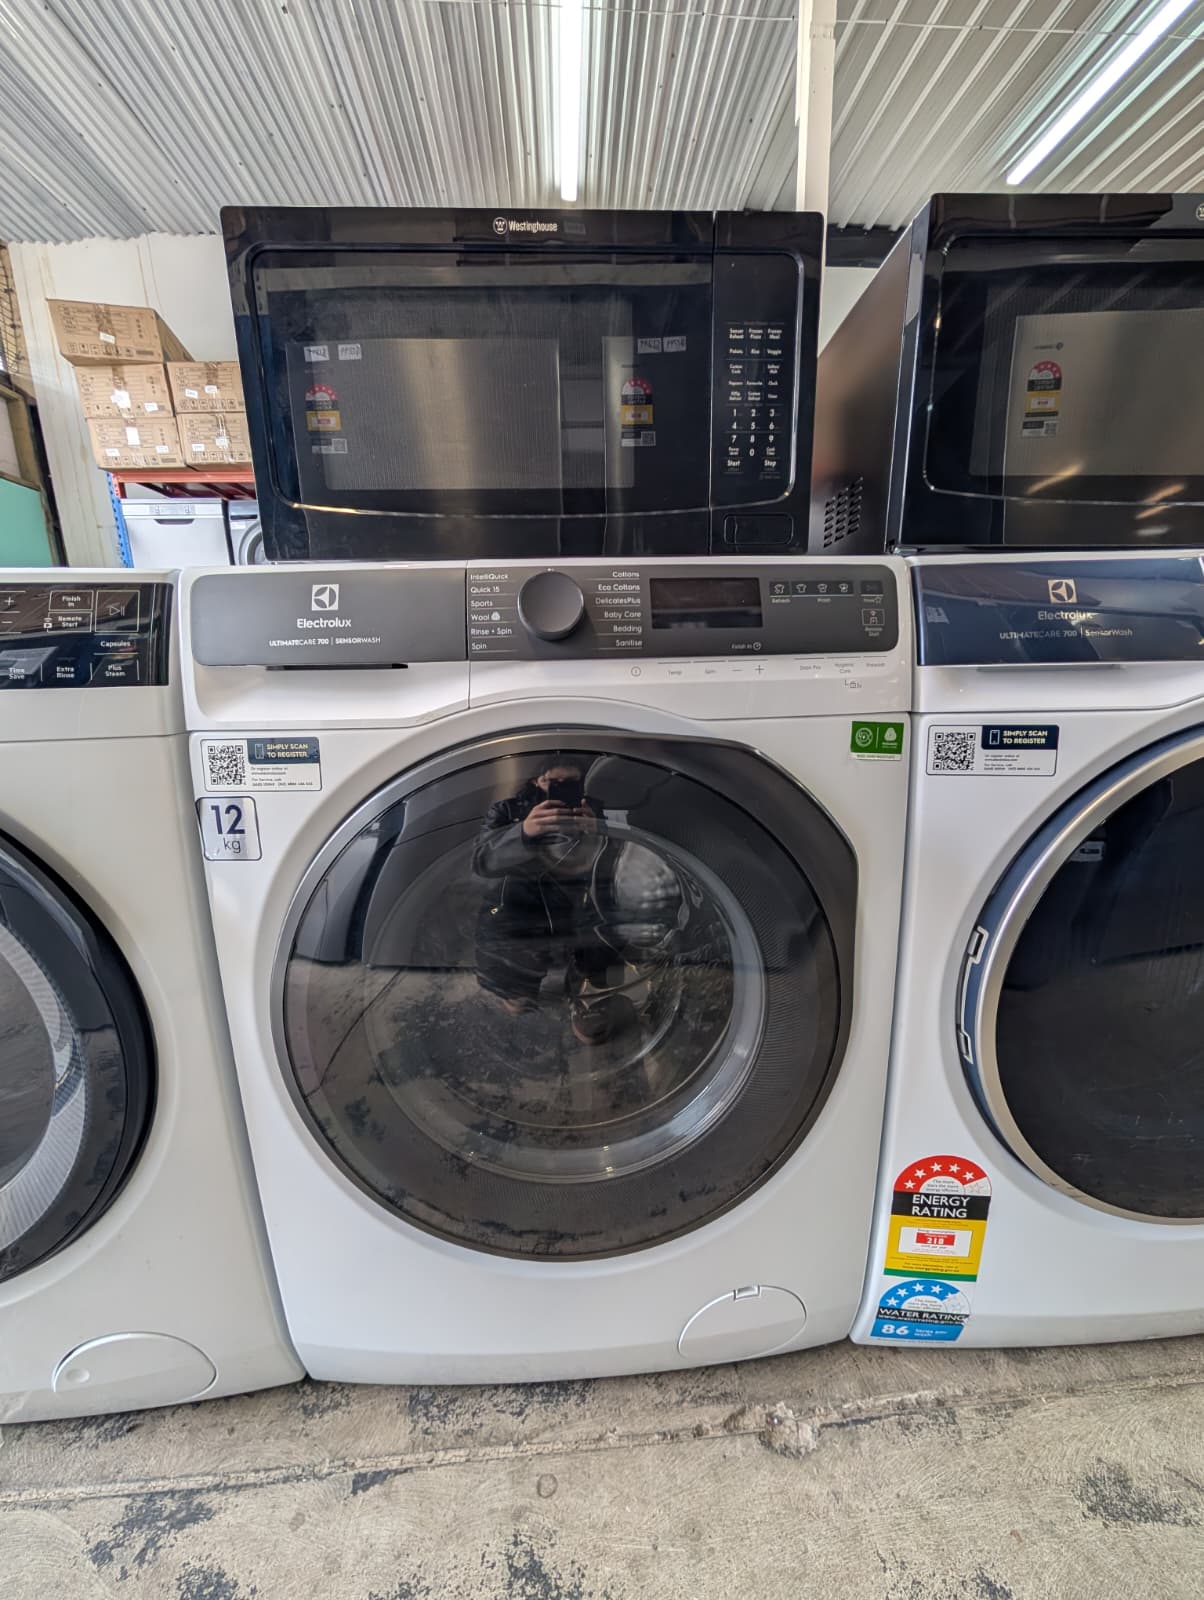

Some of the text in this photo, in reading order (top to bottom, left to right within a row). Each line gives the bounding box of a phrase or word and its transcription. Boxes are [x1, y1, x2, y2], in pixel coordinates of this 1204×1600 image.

[508, 221, 558, 234] Westinghouse
[733, 408, 737, 417] 1
[751, 408, 757, 417] 2
[769, 408, 775, 417] 3
[731, 421, 737, 430] 4
[750, 421, 756, 430] 5
[768, 421, 775, 430] 6
[731, 434, 737, 443] 7
[749, 434, 755, 443] 8
[768, 434, 774, 443] 9
[749, 448, 755, 457] 0
[727, 459, 741, 467] Start
[764, 459, 777, 468] Stop
[470, 600, 493, 608] Sports
[604, 611, 623, 619] Baby
[1038, 610, 1092, 621] Electrolux
[296, 617, 352, 629] Electrolux
[470, 628, 490, 636] Rinse
[496, 627, 512, 635] Spin
[613, 625, 642, 634] Bedding
[999, 630, 1060, 639] ULTIMATECARE
[1085, 628, 1133, 637] SensorWash
[100, 640, 131, 648] Capsules
[269, 637, 381, 647] ULTIMATECARE 700 SENSORWASH
[471, 642, 487, 650] Spin
[616, 639, 643, 647] Sanitise
[210, 804, 246, 835] 12
[223, 838, 241, 854] kg
[912, 1194, 970, 1207] ENERGY
[911, 1206, 968, 1219] RATING
[879, 1308, 966, 1321] WATER RATING
[881, 1324, 910, 1336] 86
